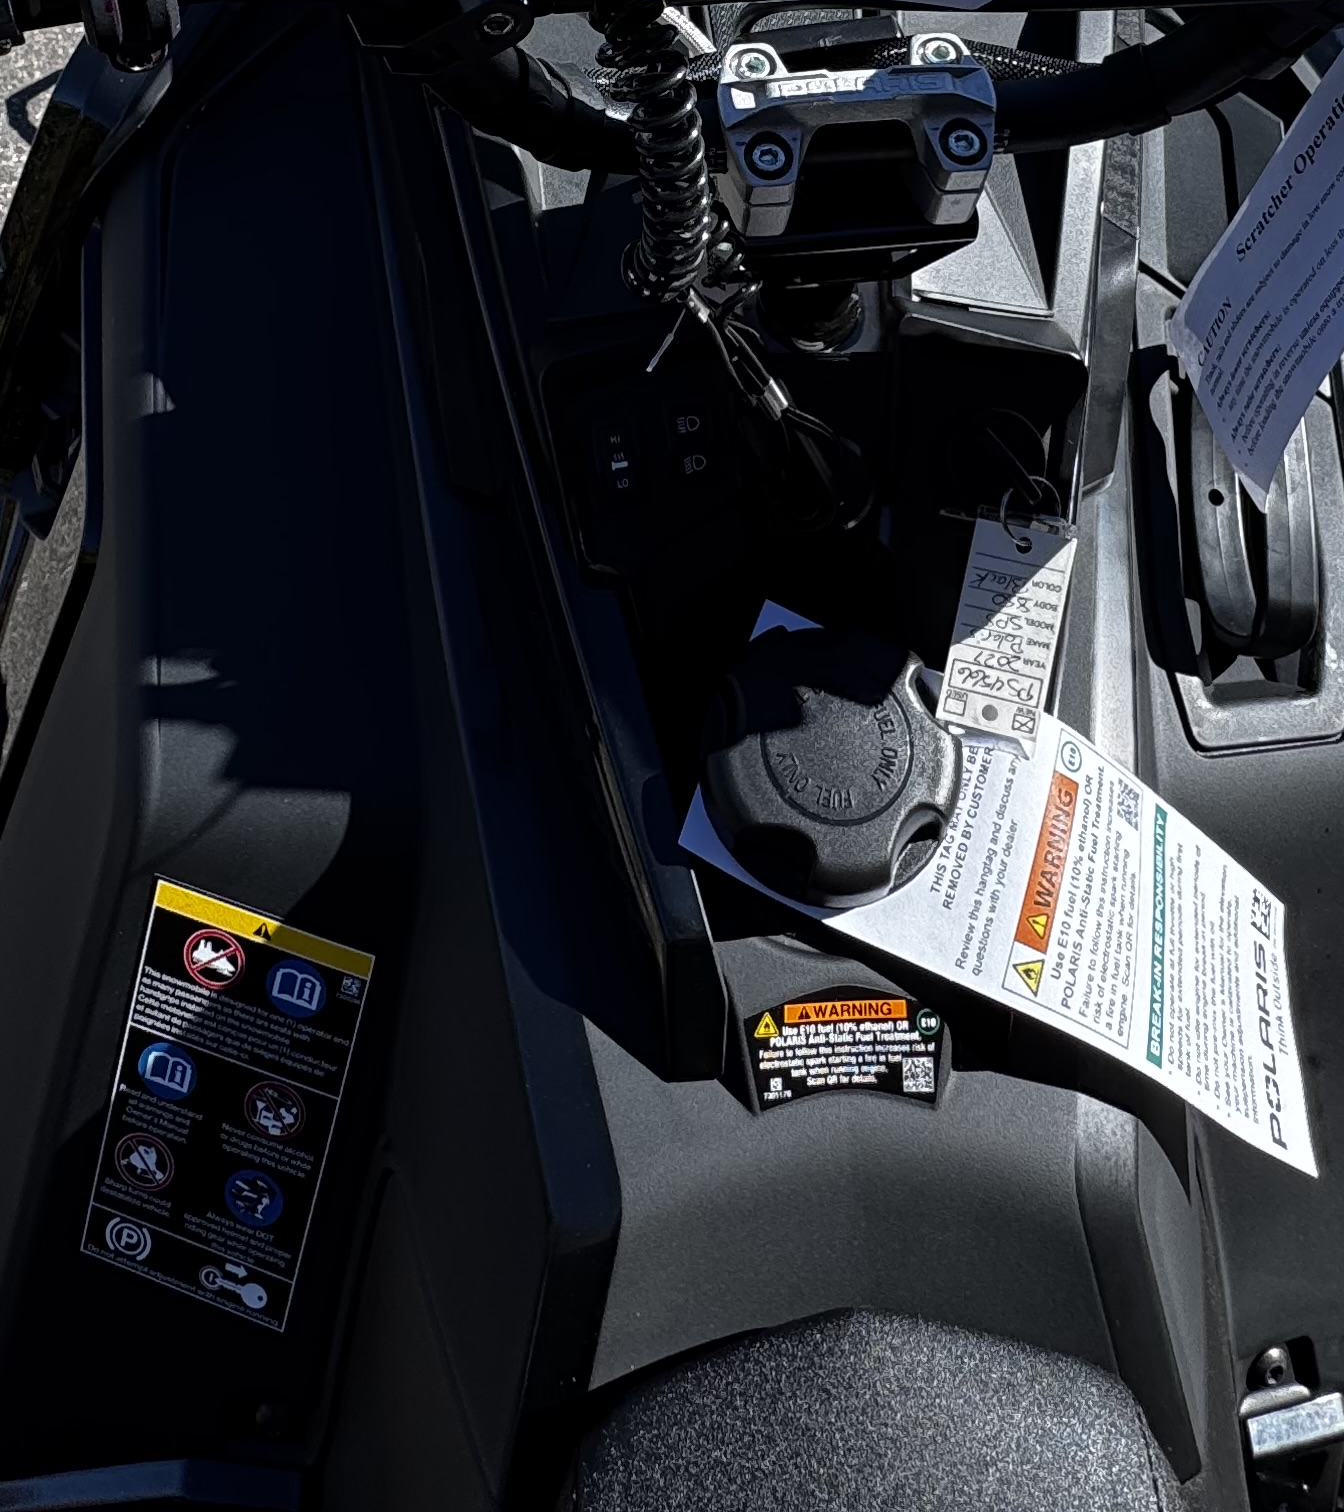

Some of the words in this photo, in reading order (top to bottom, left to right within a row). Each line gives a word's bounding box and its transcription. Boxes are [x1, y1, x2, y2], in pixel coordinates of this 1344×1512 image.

[778, 72, 940, 95] POLARIS
[1233, 174, 1296, 263] Scratcher
[1253, 266, 1275, 295] subject
[1278, 228, 1304, 260] damage
[1306, 202, 1321, 220] low
[1288, 266, 1317, 307] operated
[1315, 257, 1326, 270] on
[1322, 237, 1339, 257] less
[1196, 296, 1233, 367] CAUTION
[1278, 338, 1300, 371] reverse
[1299, 310, 1320, 340] unless
[609, 433, 621, 444] HI
[616, 478, 629, 489] LO
[969, 568, 1030, 597] Black
[1031, 579, 1061, 593] COLOR
[1033, 599, 1058, 612] BODY
[1023, 617, 1054, 630] MODEL
[967, 626, 1026, 654] Polaris
[1025, 638, 1050, 649] MAKE
[1022, 657, 1046, 668] YEAR
[775, 752, 810, 793] ONLY
[871, 746, 899, 792] ONLY
[1007, 751, 1021, 777] any
[816, 784, 855, 809] FUEL
[966, 745, 994, 821] CUSTOMER
[994, 775, 1013, 821] discuss
[1083, 772, 1093, 796] OR
[929, 859, 947, 900] THIS
[939, 830, 955, 865] TAG
[957, 765, 972, 803] ONLY
[965, 743, 979, 765] BE
[1105, 779, 1114, 833] increases
[960, 819, 974, 842] BY
[988, 820, 1001, 846] and
[1001, 817, 1018, 859] dealer
[1033, 785, 1073, 913] WARNING
[1067, 746, 1077, 767] E10
[1076, 796, 1092, 853] ethanol)
[1099, 833, 1112, 894] instruction
[1111, 829, 1122, 873] starting
[942, 839, 968, 914] REMOVED
[974, 845, 997, 897] hangtag
[995, 857, 1009, 888] your
[1069, 851, 1083, 890] (10%
[1120, 847, 1130, 892] running
[1154, 812, 1163, 959] RESPONSIBILITY
[987, 886, 1001, 915] with
[1063, 888, 1077, 920] fuel
[1095, 894, 1105, 918] this
[1107, 873, 1119, 908] spark
[968, 896, 982, 922] this
[1060, 938, 1083, 1010] POLARIS
[1074, 863, 1094, 939] Anti-Static
[1087, 831, 1098, 864] Fuel
[1117, 892, 1126, 927] when
[1126, 911, 1134, 929] for
[954, 921, 975, 971] Review
[971, 913, 994, 978] questions
[1057, 918, 1071, 950] E10
[1090, 918, 1102, 956] follow
[1099, 907, 1114, 984] electrostatic
[1114, 926, 1123, 955] tank
[1124, 930, 1133, 953] QR
[1050, 949, 1065, 981] Use
[1087, 956, 1096, 971] to
[1110, 955, 1120, 981] fuel
[1121, 952, 1131, 987] Scan
[142, 965, 161, 979] This
[160, 971, 210, 997] snowmobile
[1078, 971, 1094, 1018] Failure
[1095, 982, 1105, 999] of
[1109, 981, 1116, 996] in
[1270, 950, 1281, 1010] Outside
[813, 1002, 892, 1017] WARNING
[920, 1017, 936, 1027] E10
[1092, 999, 1103, 1024] risk
[1105, 996, 1115, 1019] fire
[1150, 960, 1161, 1057] BREAK-IN
[769, 1035, 806, 1047] POLARIS
[808, 1033, 853, 1044] Anti-Static
[855, 1031, 873, 1041] Fuel
[782, 1026, 797, 1035] Use
[799, 1024, 815, 1034] E10
[817, 1023, 833, 1033] fuel
[835, 1022, 857, 1033] (10%
[859, 1020, 893, 1031] ethanol)
[896, 1020, 908, 1030] OR
[1274, 1012, 1288, 1058] Think
[1253, 939, 1287, 1150] POLARIS
